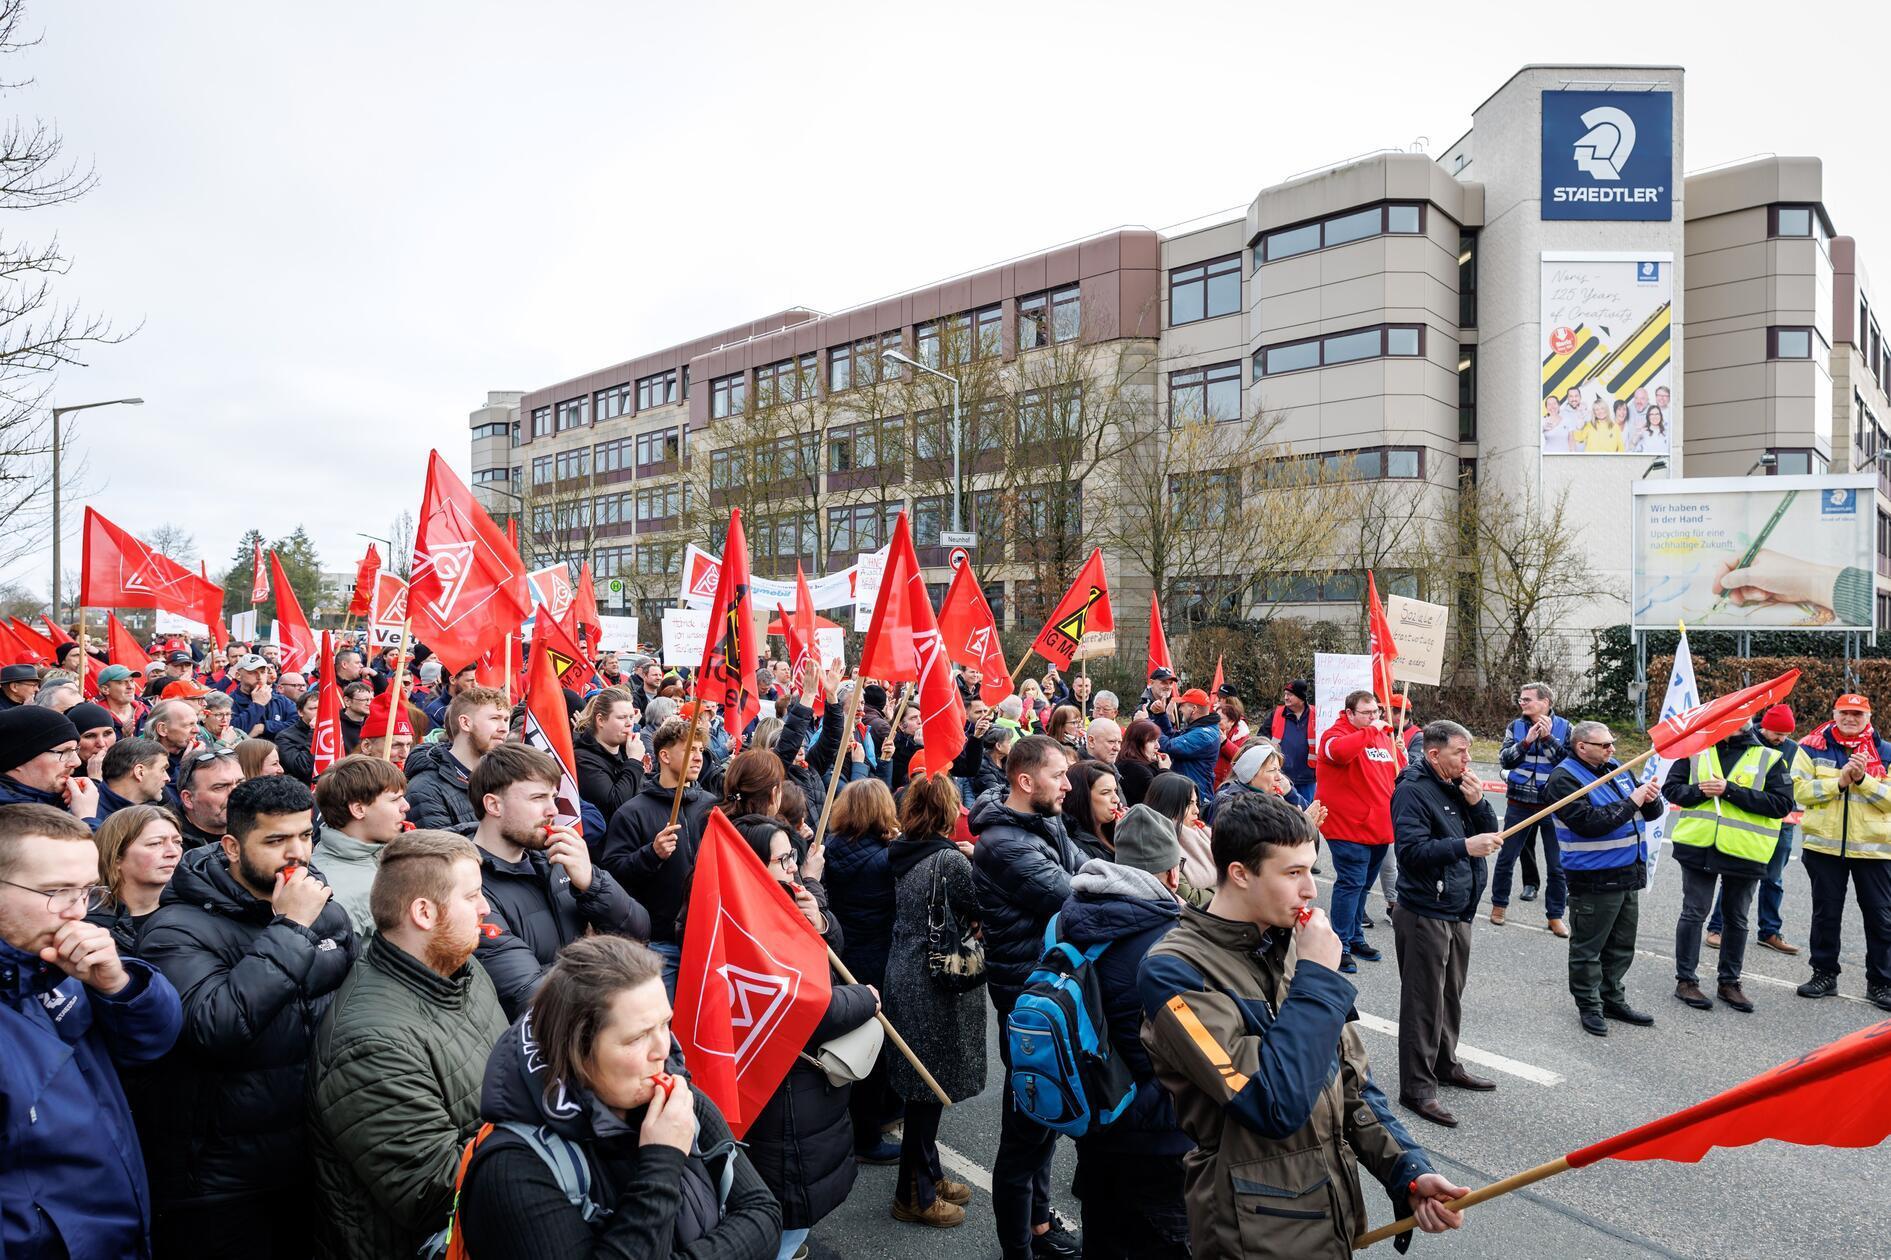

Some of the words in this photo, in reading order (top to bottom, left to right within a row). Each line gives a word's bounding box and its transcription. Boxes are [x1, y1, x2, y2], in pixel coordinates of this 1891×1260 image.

[1552, 288, 1576, 300] 125
[1581, 288, 1620, 304] Years
[1550, 307, 1565, 323] of
[1568, 305, 1632, 323] Creativity
[1650, 504, 1666, 512] Wir
[1669, 503, 1697, 512] haben
[1650, 516, 1659, 524] in
[1662, 515, 1676, 523] der
[1680, 515, 1704, 523] Hand
[1650, 530, 1690, 539] Upcycling
[1693, 529, 1704, 537] für
[1707, 529, 1725, 537] eine
[1650, 541, 1699, 551] nachhaltige
[1043, 629, 1059, 647] IG
